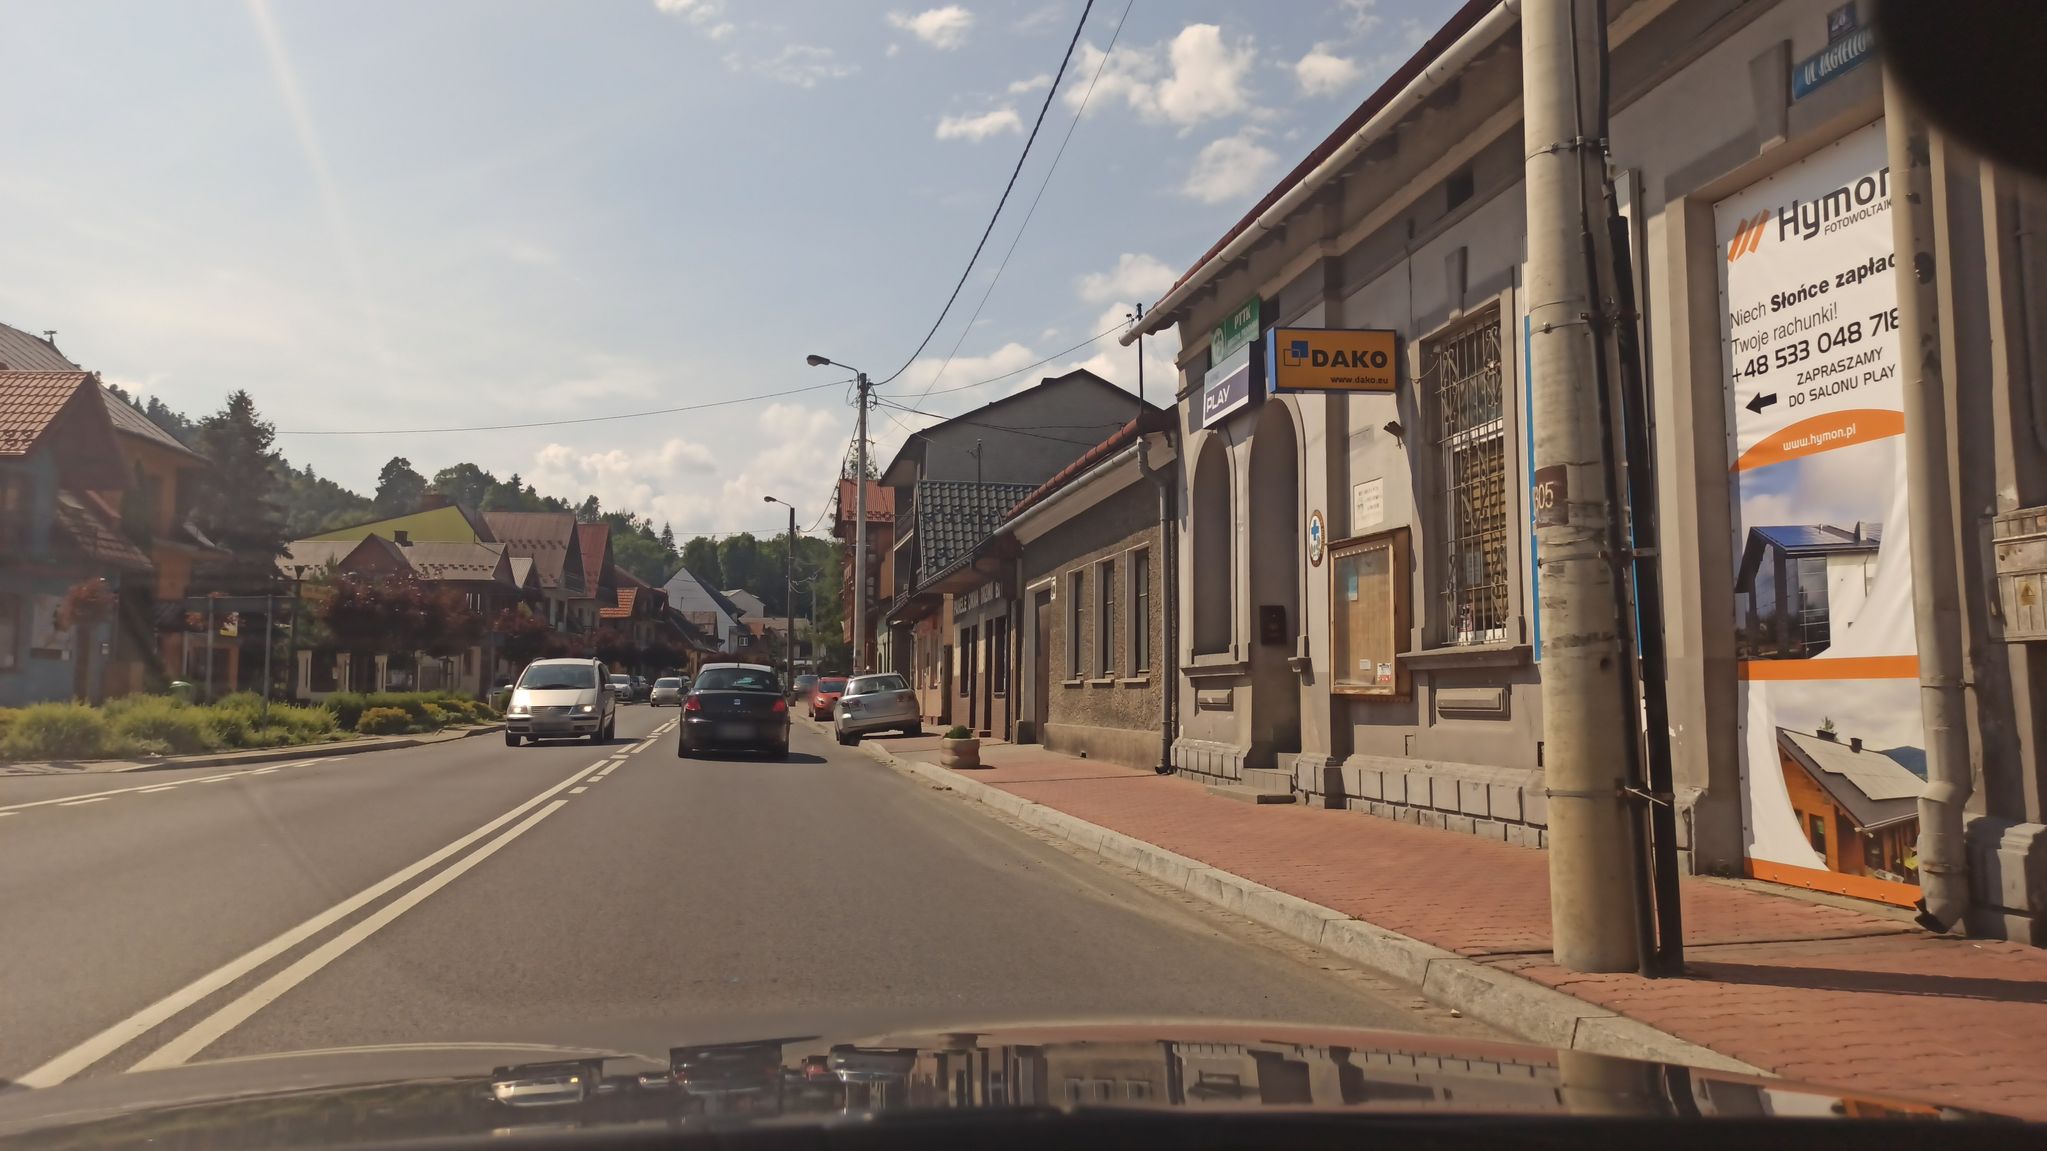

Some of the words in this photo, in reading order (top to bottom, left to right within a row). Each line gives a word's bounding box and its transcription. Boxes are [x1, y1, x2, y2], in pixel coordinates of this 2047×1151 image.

[1819, 30, 1874, 77] JAGIELLO
[1731, 301, 1767, 329] Niech
[1770, 279, 1830, 313] Słońce
[1731, 330, 1769, 355] Twoje
[1773, 301, 1839, 341] rachunki!
[1311, 349, 1388, 369] DAKO
[1732, 354, 1769, 383] +48
[1775, 339, 1810, 369] 533
[1817, 321, 1862, 353] 048
[1796, 346, 1884, 386] ZAPRASZAMY
[1206, 384, 1230, 413] PLAY
[1330, 375, 1389, 385] www.dako.eu
[1788, 392, 1806, 408] DO
[1809, 375, 1859, 402] SALONU
[1863, 363, 1897, 386] PLAY
[1782, 423, 1857, 452] www.hymon.pl
